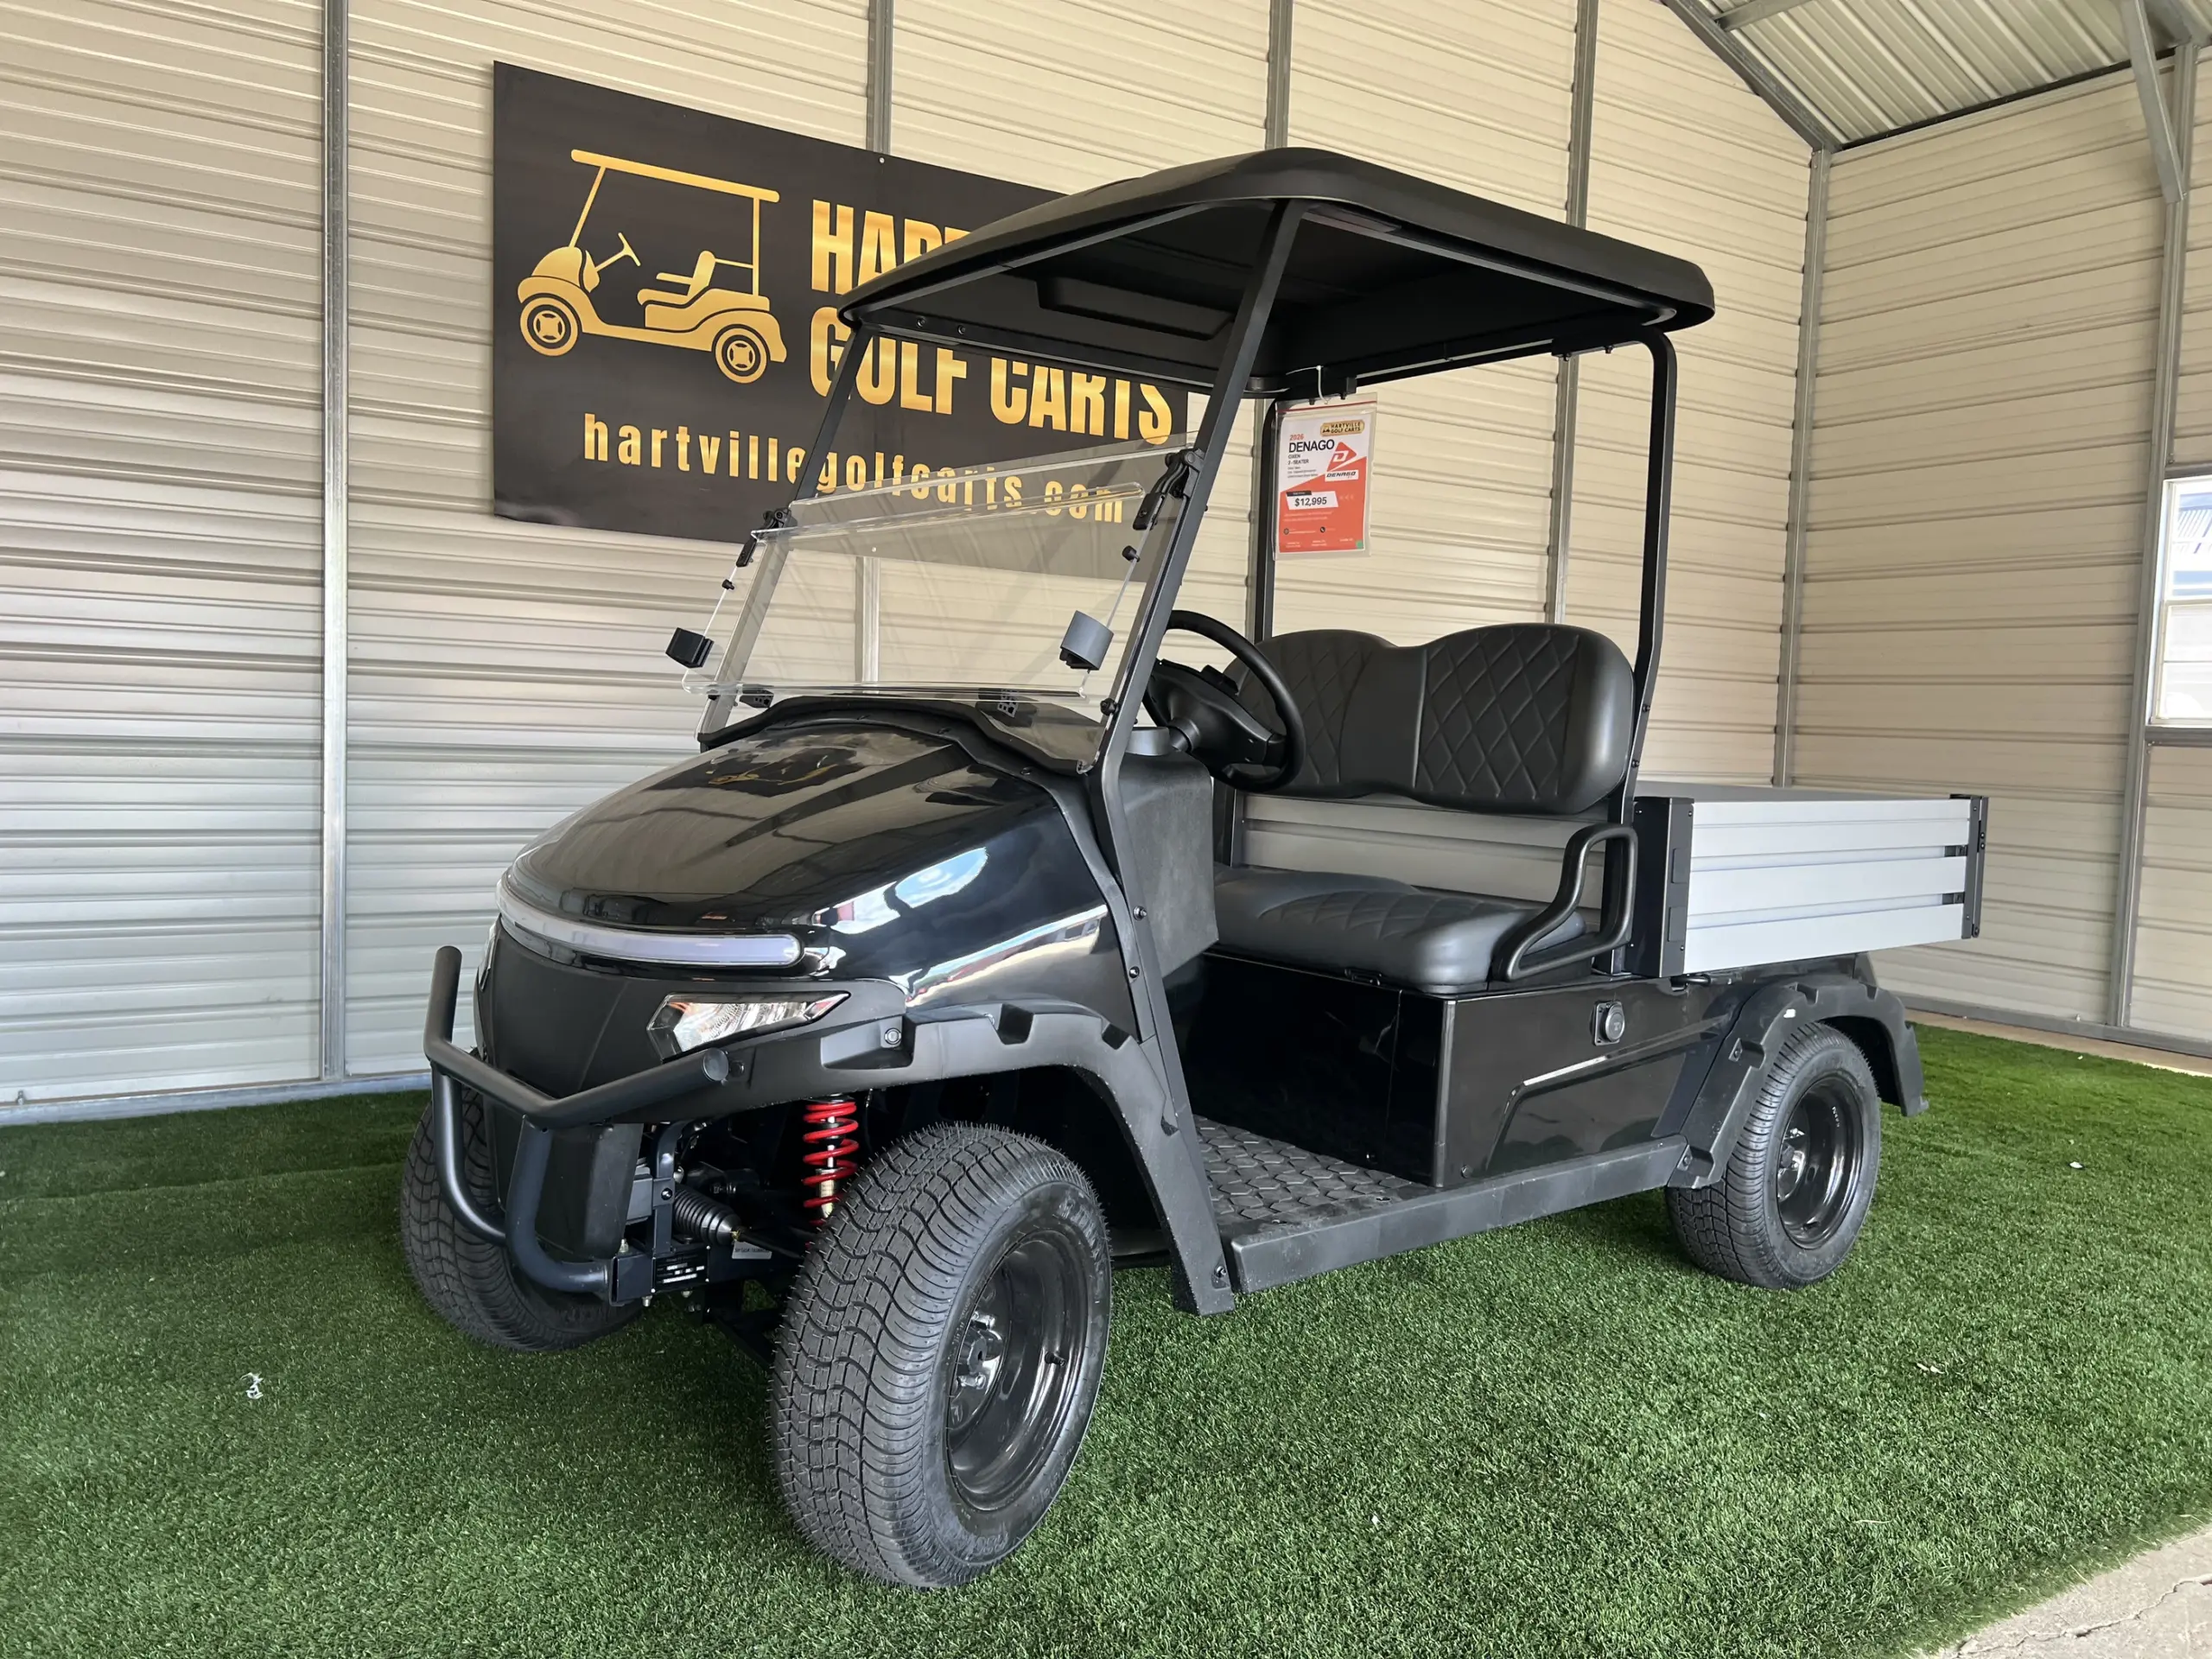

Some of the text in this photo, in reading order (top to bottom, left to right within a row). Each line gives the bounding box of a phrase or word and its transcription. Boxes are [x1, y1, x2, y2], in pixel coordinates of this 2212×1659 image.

[810, 306, 1173, 446] GOLF CARTS
[1288, 439, 1335, 453] DENAGO
[1294, 497, 1327, 506] $12,995
